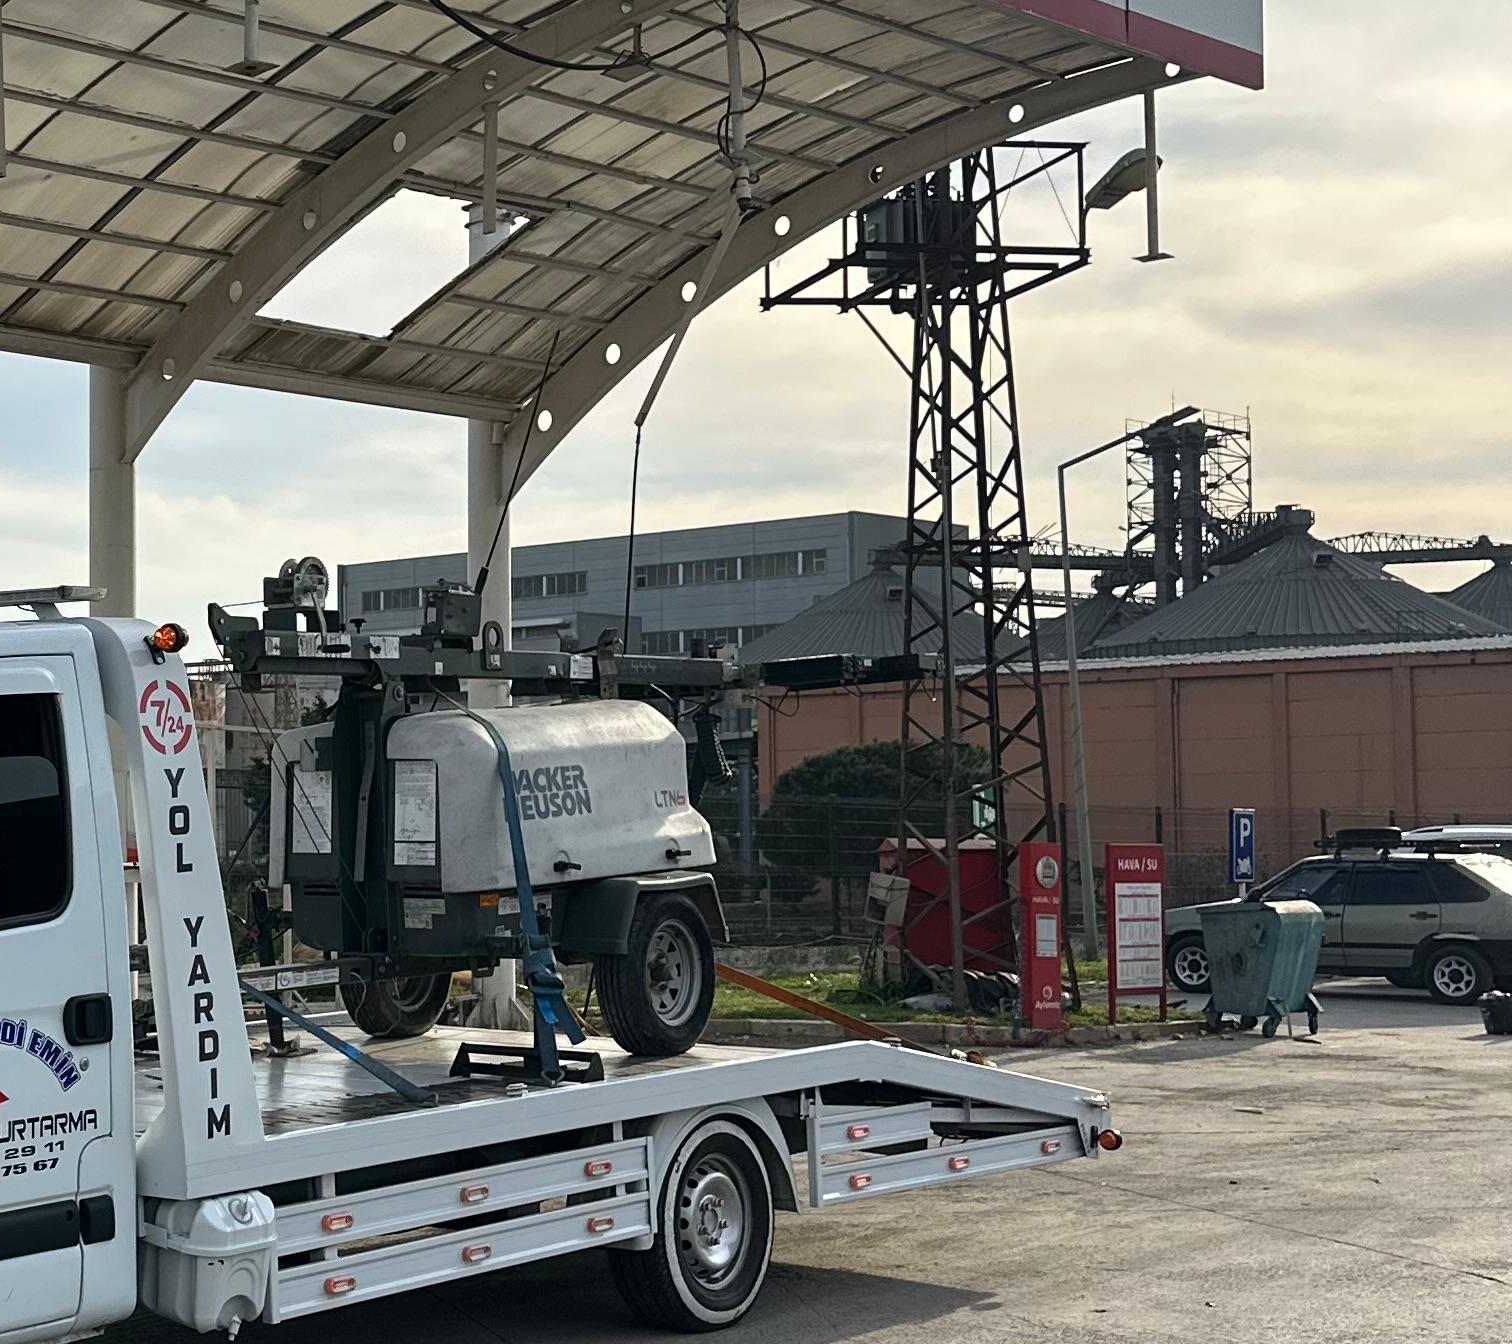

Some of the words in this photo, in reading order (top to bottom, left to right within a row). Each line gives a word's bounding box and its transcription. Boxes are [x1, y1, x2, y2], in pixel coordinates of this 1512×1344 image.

[150, 698, 185, 737] 7/24
[516, 789, 592, 820] EUSON
[653, 789, 686, 808] LTN6
[1240, 818, 1251, 847] P
[1118, 859, 1140, 871] HAVA
[1147, 859, 1158, 871] SU
[164, 768, 193, 873] YOL
[183, 916, 231, 1140] YARDIM
[26, 1029, 81, 1092] EMİN
[4, 1145, 36, 1160] 29
[44, 1140, 65, 1152] 11
[1, 1163, 27, 1177] 75
[33, 1157, 59, 1171] 67
